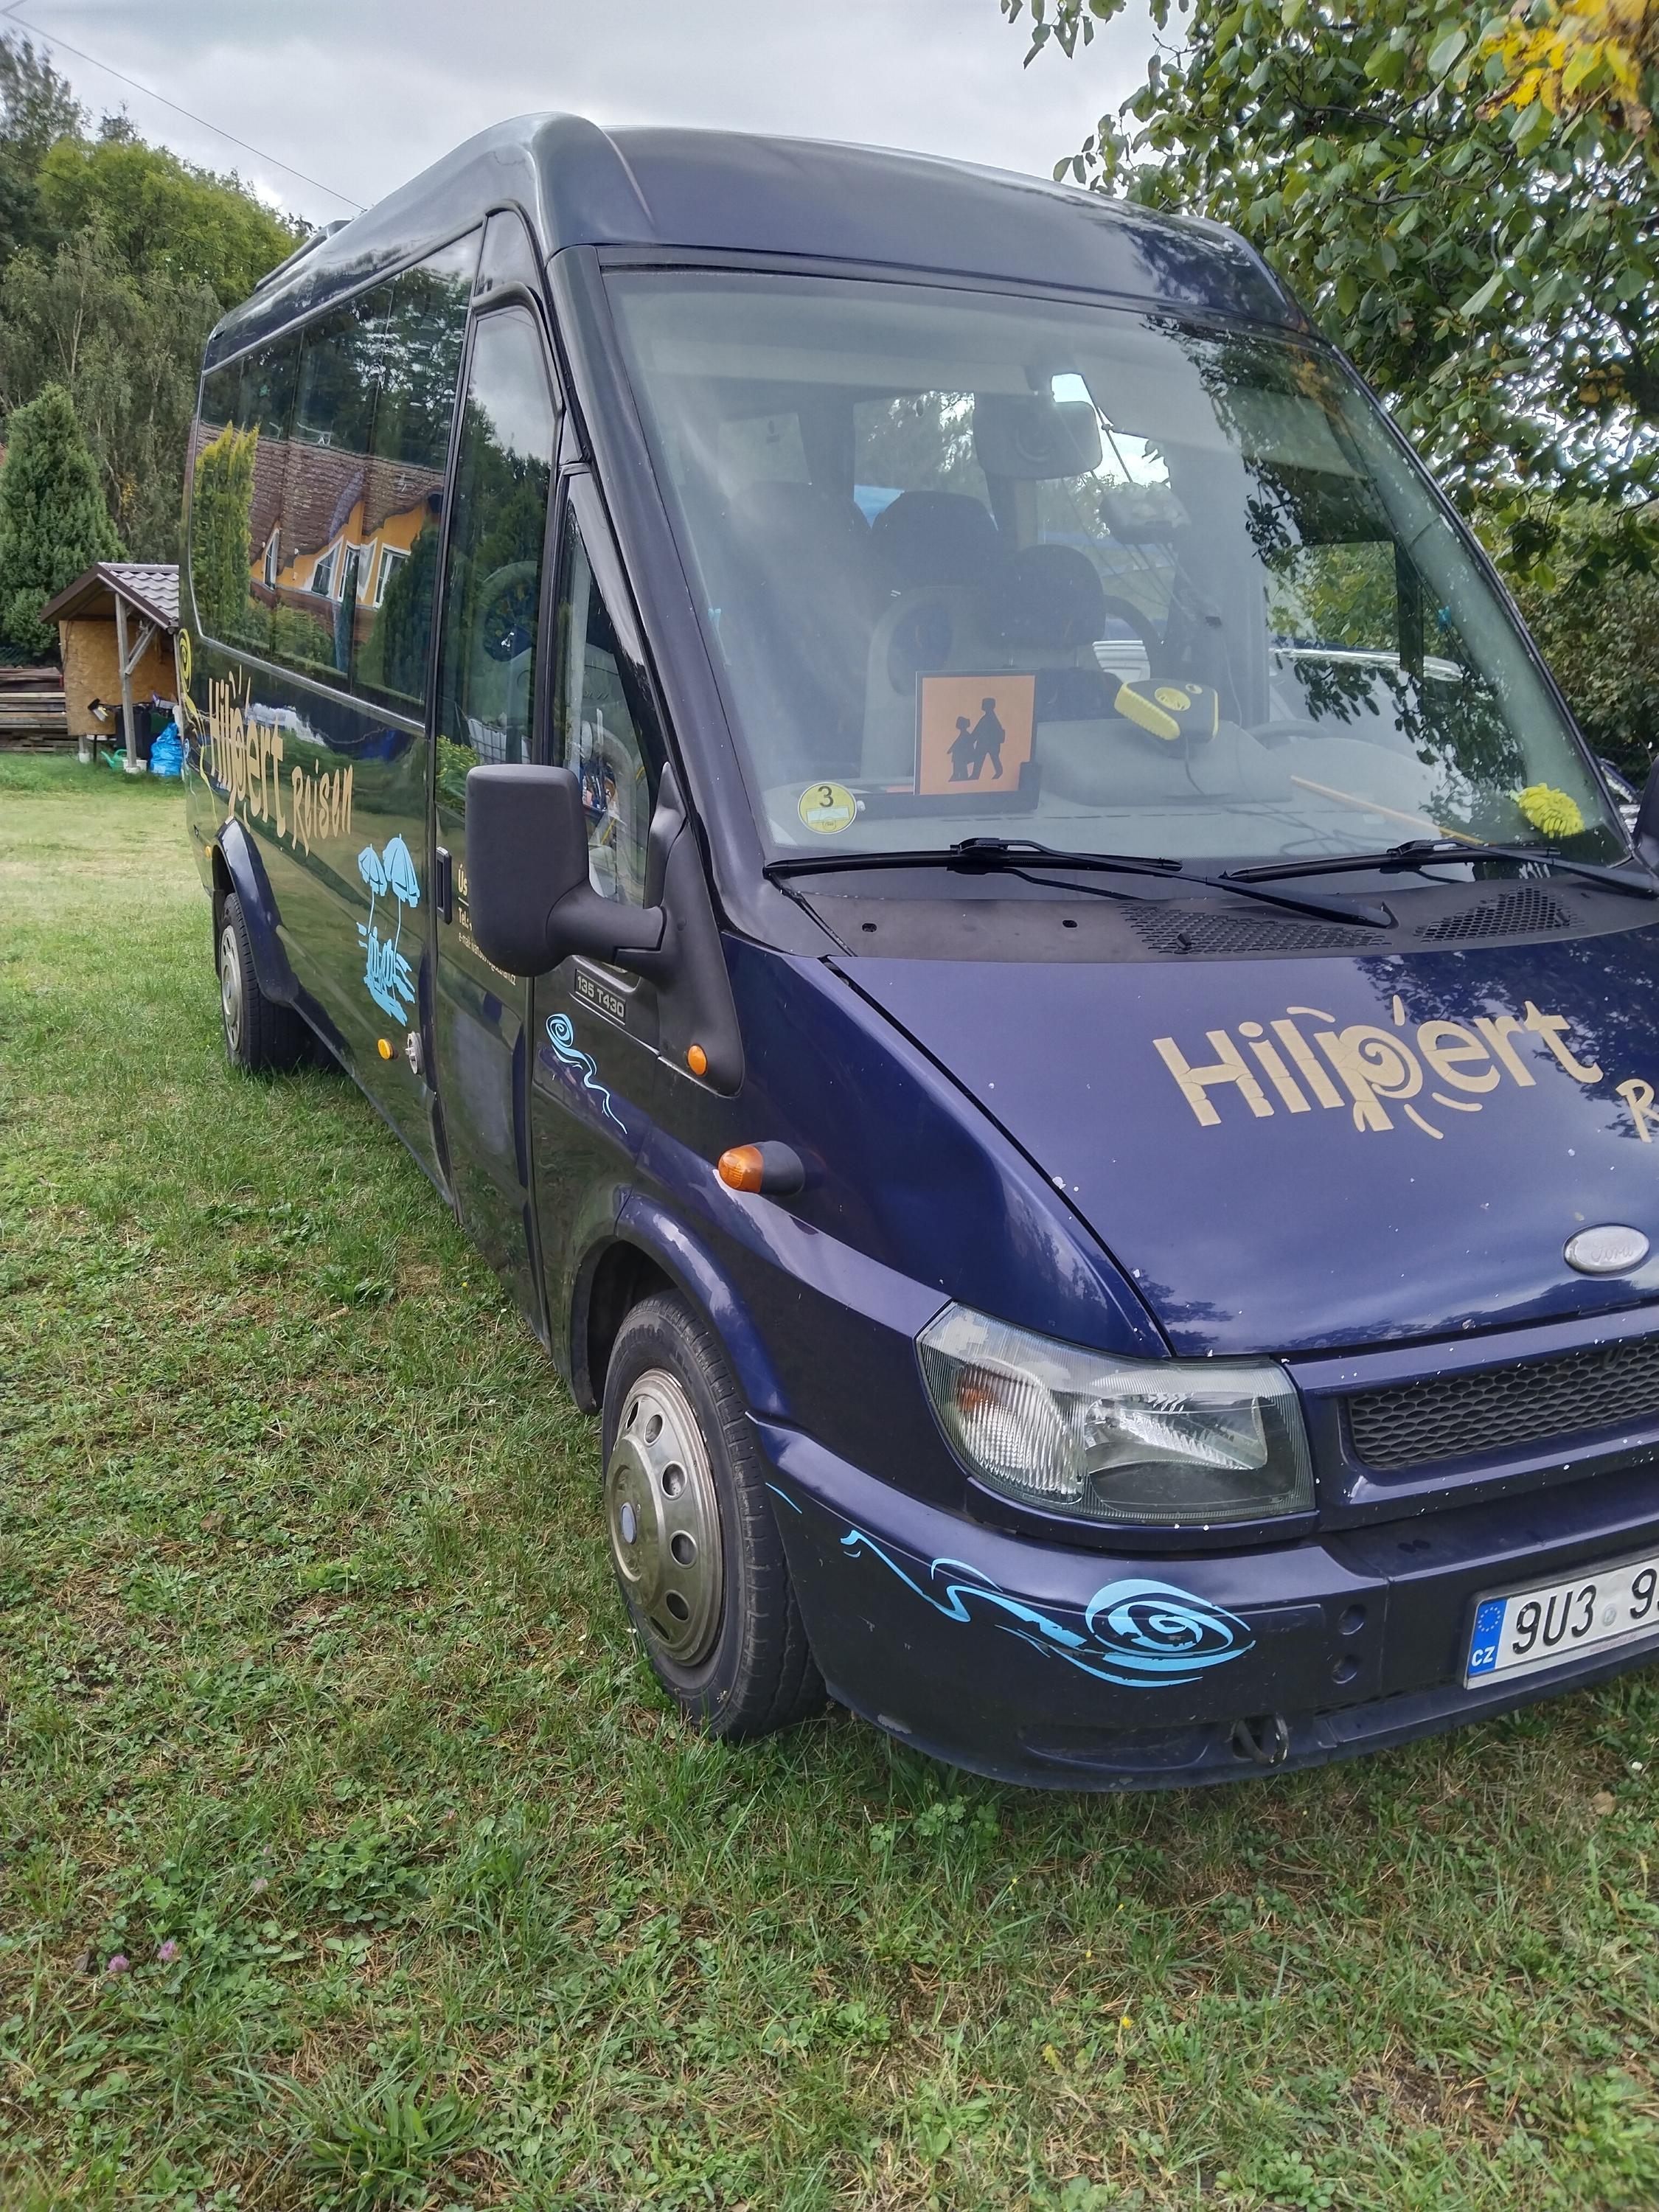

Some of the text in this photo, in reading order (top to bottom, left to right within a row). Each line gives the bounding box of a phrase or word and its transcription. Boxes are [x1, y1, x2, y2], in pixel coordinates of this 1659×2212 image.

[209, 678, 353, 858] Hilpert Reisen
[817, 785, 834, 808] 3
[458, 863, 468, 897] Ús
[577, 975, 625, 1018] 135 T430
[1152, 998, 1659, 1144] Hilpert R
[1512, 1568, 1659, 1655] 9U3 9
[1471, 1645, 1496, 1667] CZ
